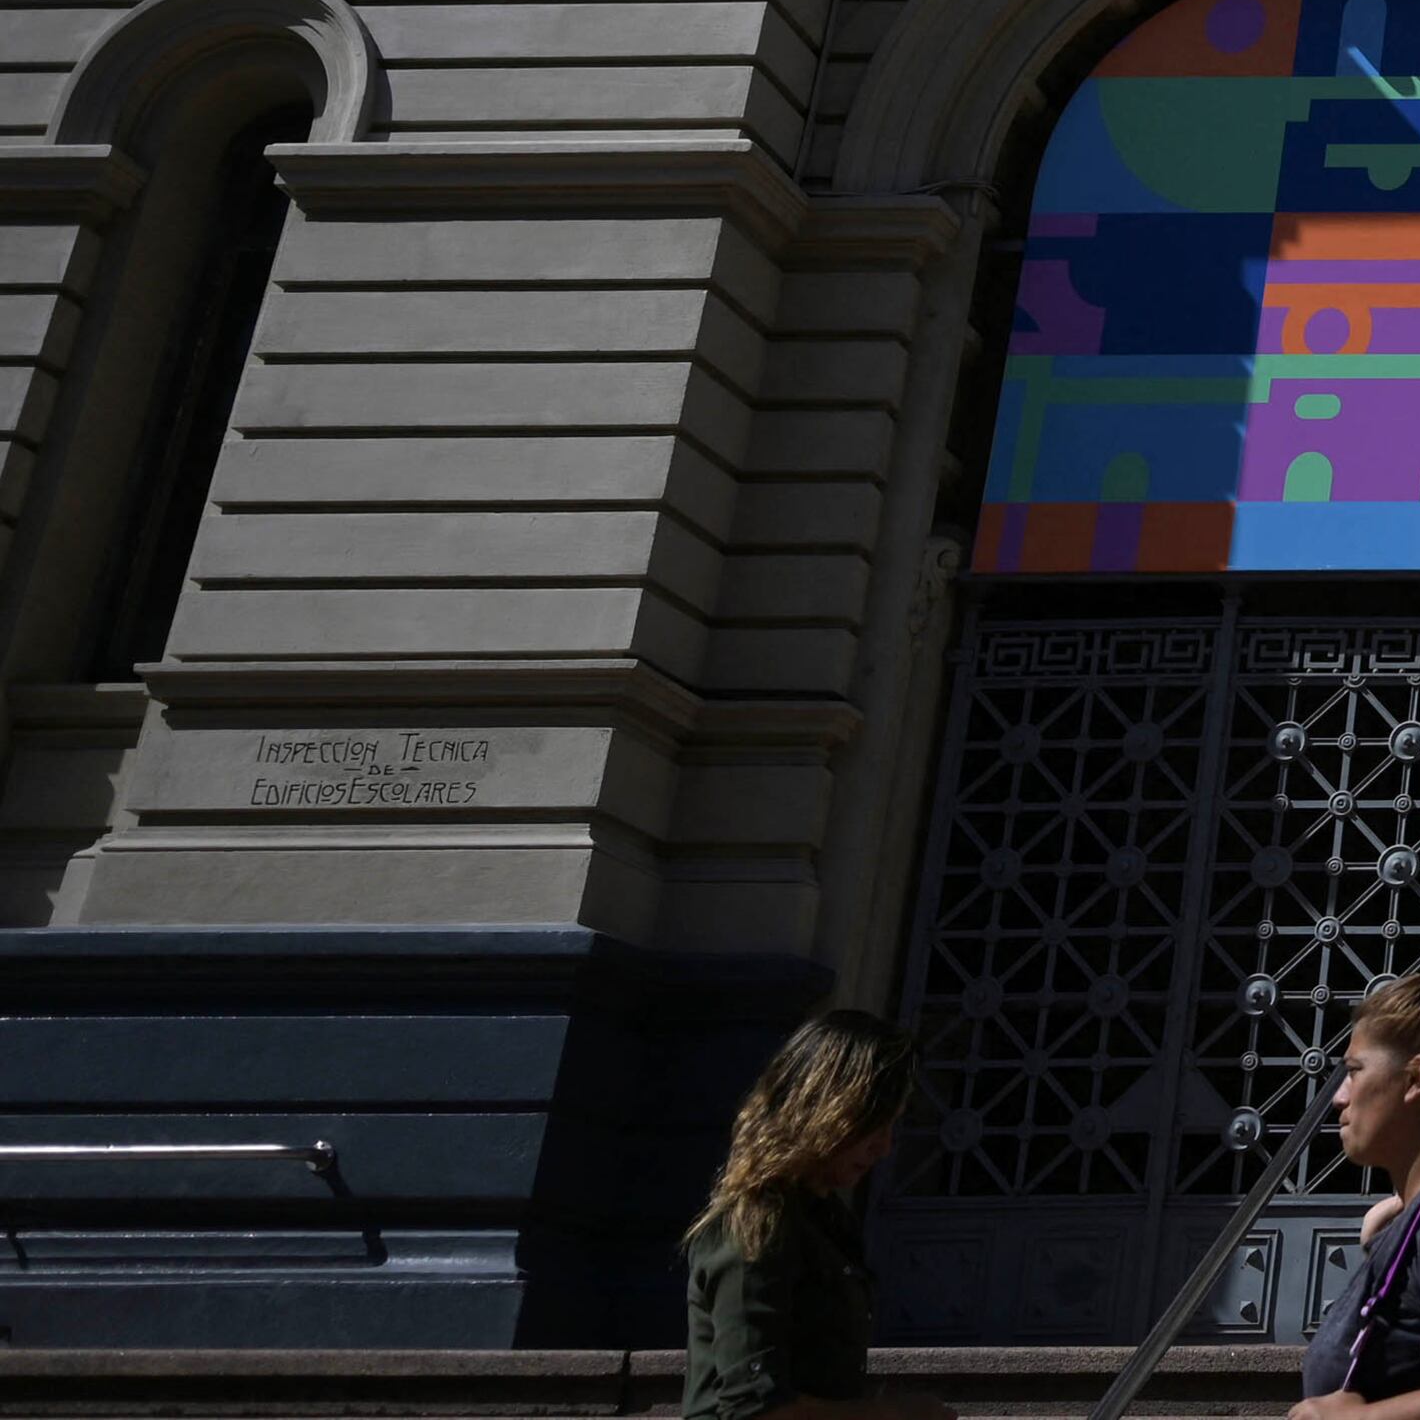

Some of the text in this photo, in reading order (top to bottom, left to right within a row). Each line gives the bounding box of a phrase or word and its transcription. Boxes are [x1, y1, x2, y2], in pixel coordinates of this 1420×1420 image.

[399, 732, 489, 762] TECNICA
[367, 764, 394, 776] DE
[347, 777, 477, 805] ESCOLARES
